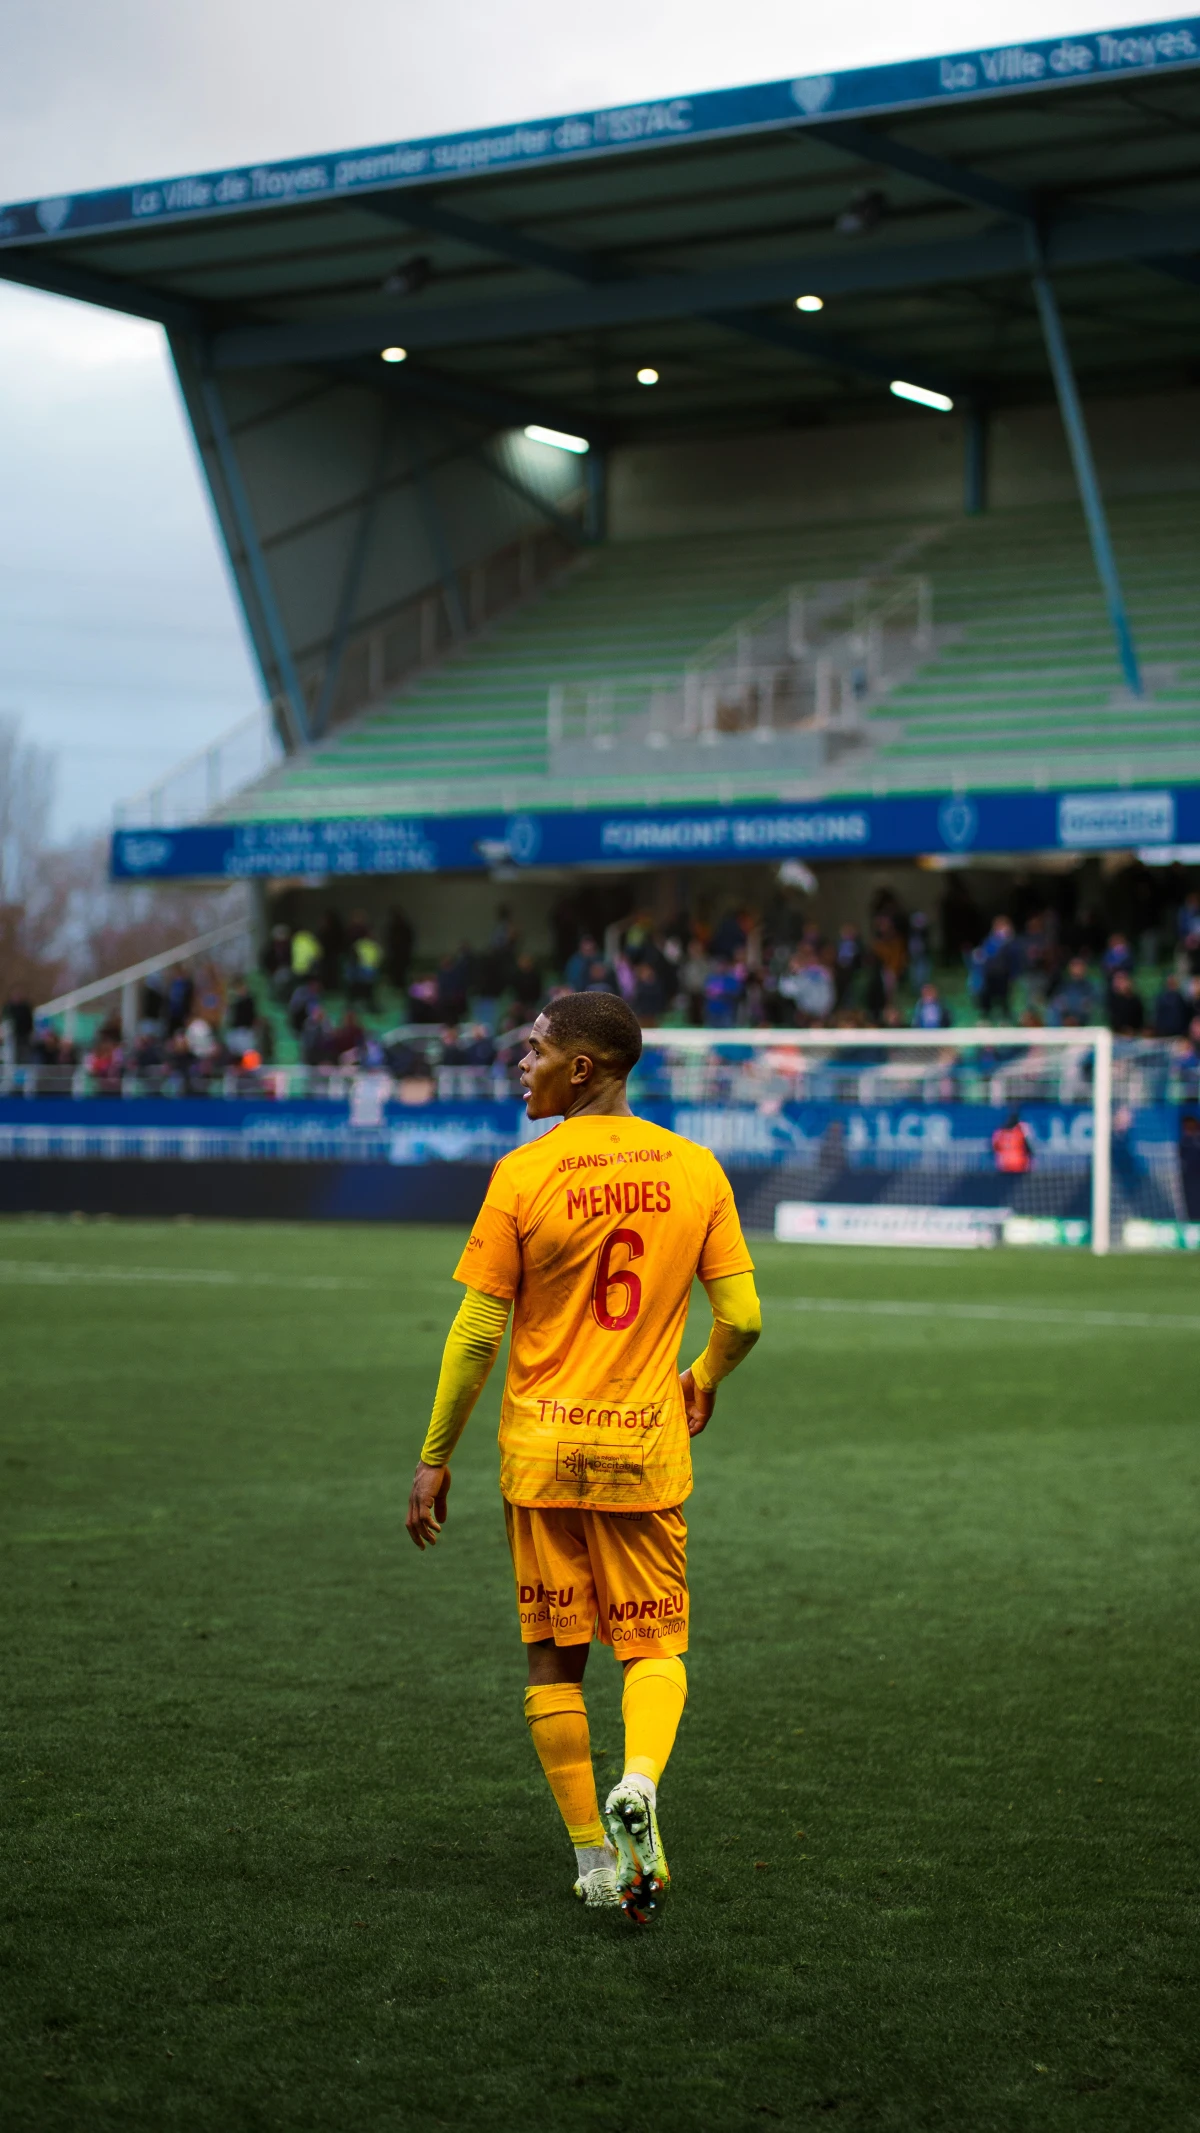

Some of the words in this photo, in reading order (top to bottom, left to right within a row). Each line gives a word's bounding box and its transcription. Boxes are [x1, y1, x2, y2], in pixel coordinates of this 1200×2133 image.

[940, 59, 977, 89] La
[981, 47, 1045, 82] Ville
[1050, 40, 1094, 73] de
[132, 187, 162, 215] La
[163, 180, 212, 209] Ville
[214, 174, 248, 201] de
[335, 145, 429, 191] premier
[432, 127, 549, 170] supporter
[553, 117, 593, 148] de
[566, 1181, 671, 1220] MENDES
[469, 1235, 484, 1249] ON
[591, 1228, 645, 1331] 6
[537, 1399, 664, 1429] Thermatic
[593, 1460, 639, 1470] Occitanie
[608, 1592, 684, 1622] NDRIEU
[611, 1620, 686, 1641] Construction
